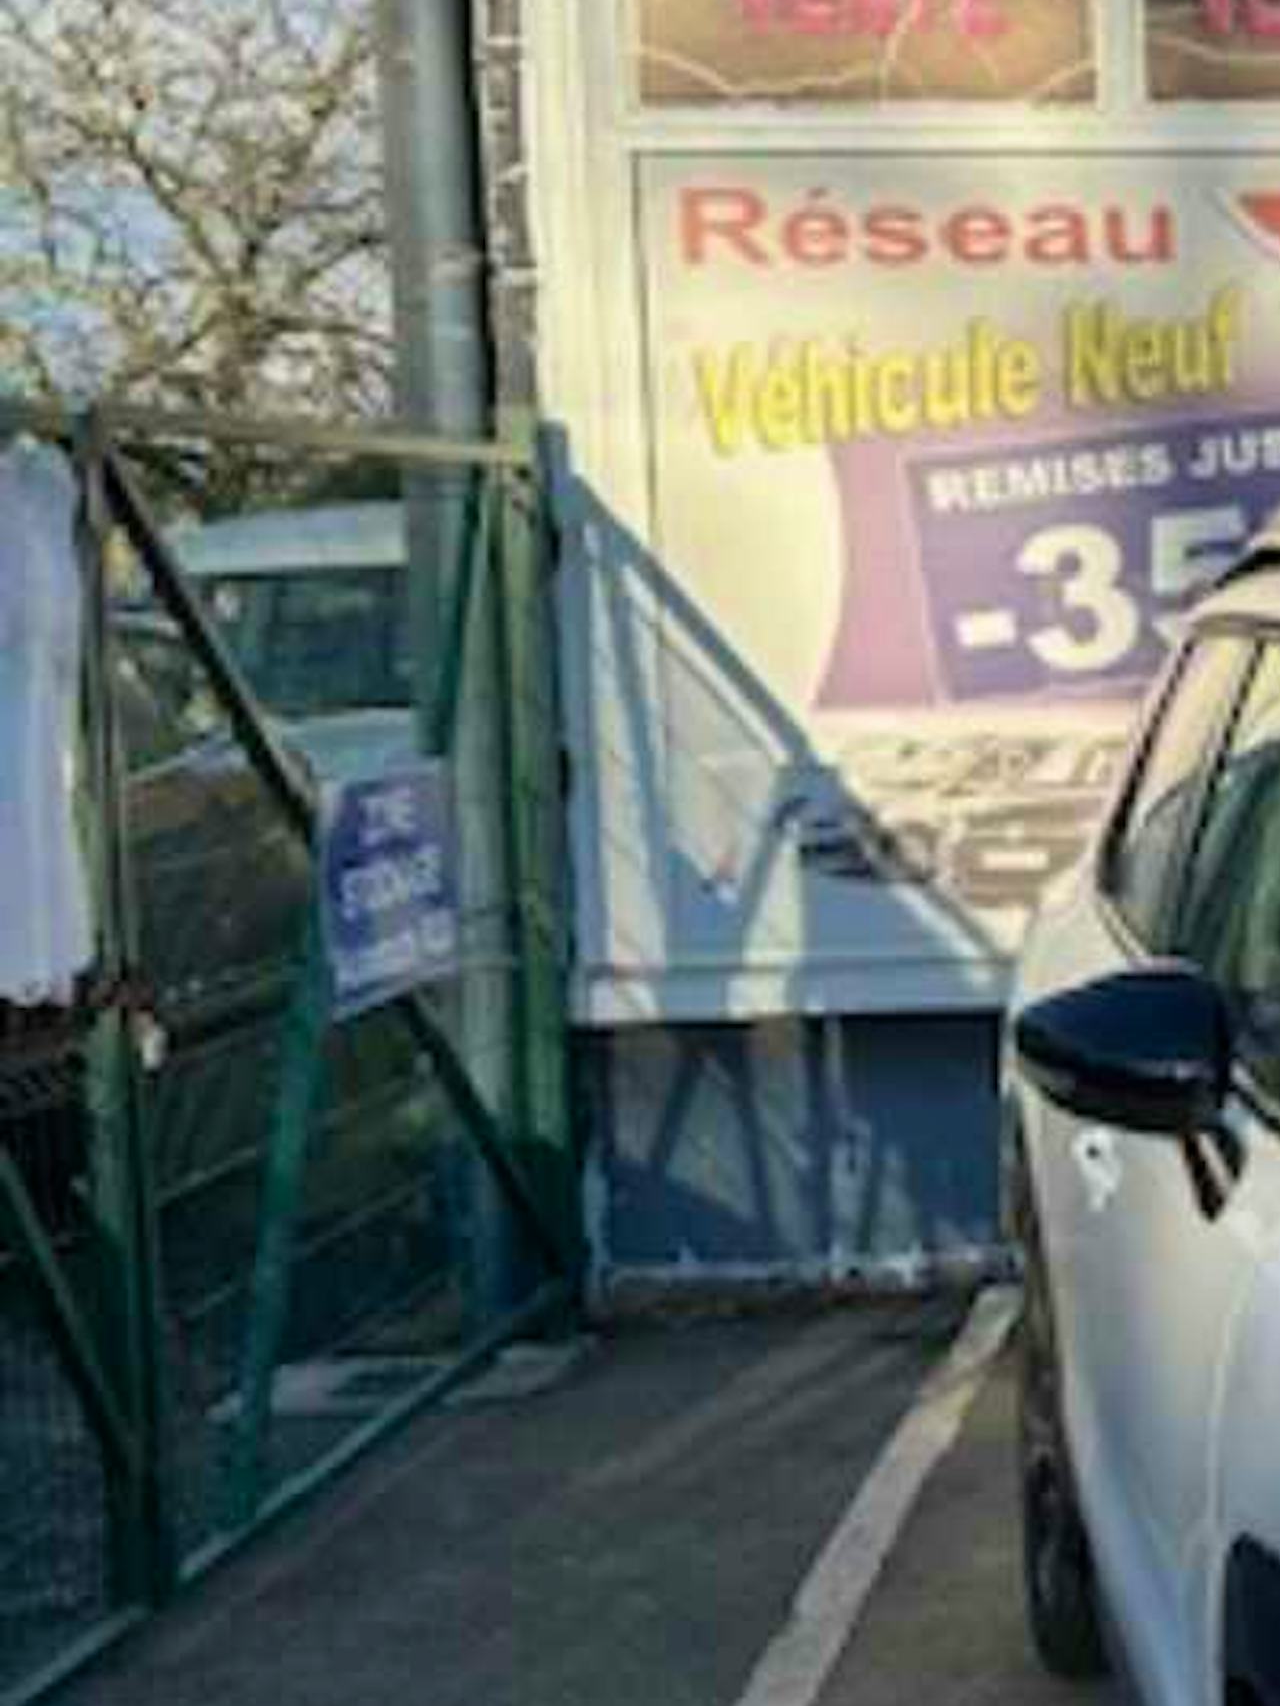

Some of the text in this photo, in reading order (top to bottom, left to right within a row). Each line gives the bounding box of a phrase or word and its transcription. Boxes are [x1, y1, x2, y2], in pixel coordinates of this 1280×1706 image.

[677, 186, 1176, 265] Réseau
[694, 288, 1246, 456] Véhicule Neuf
[927, 444, 1170, 512] REMISES
